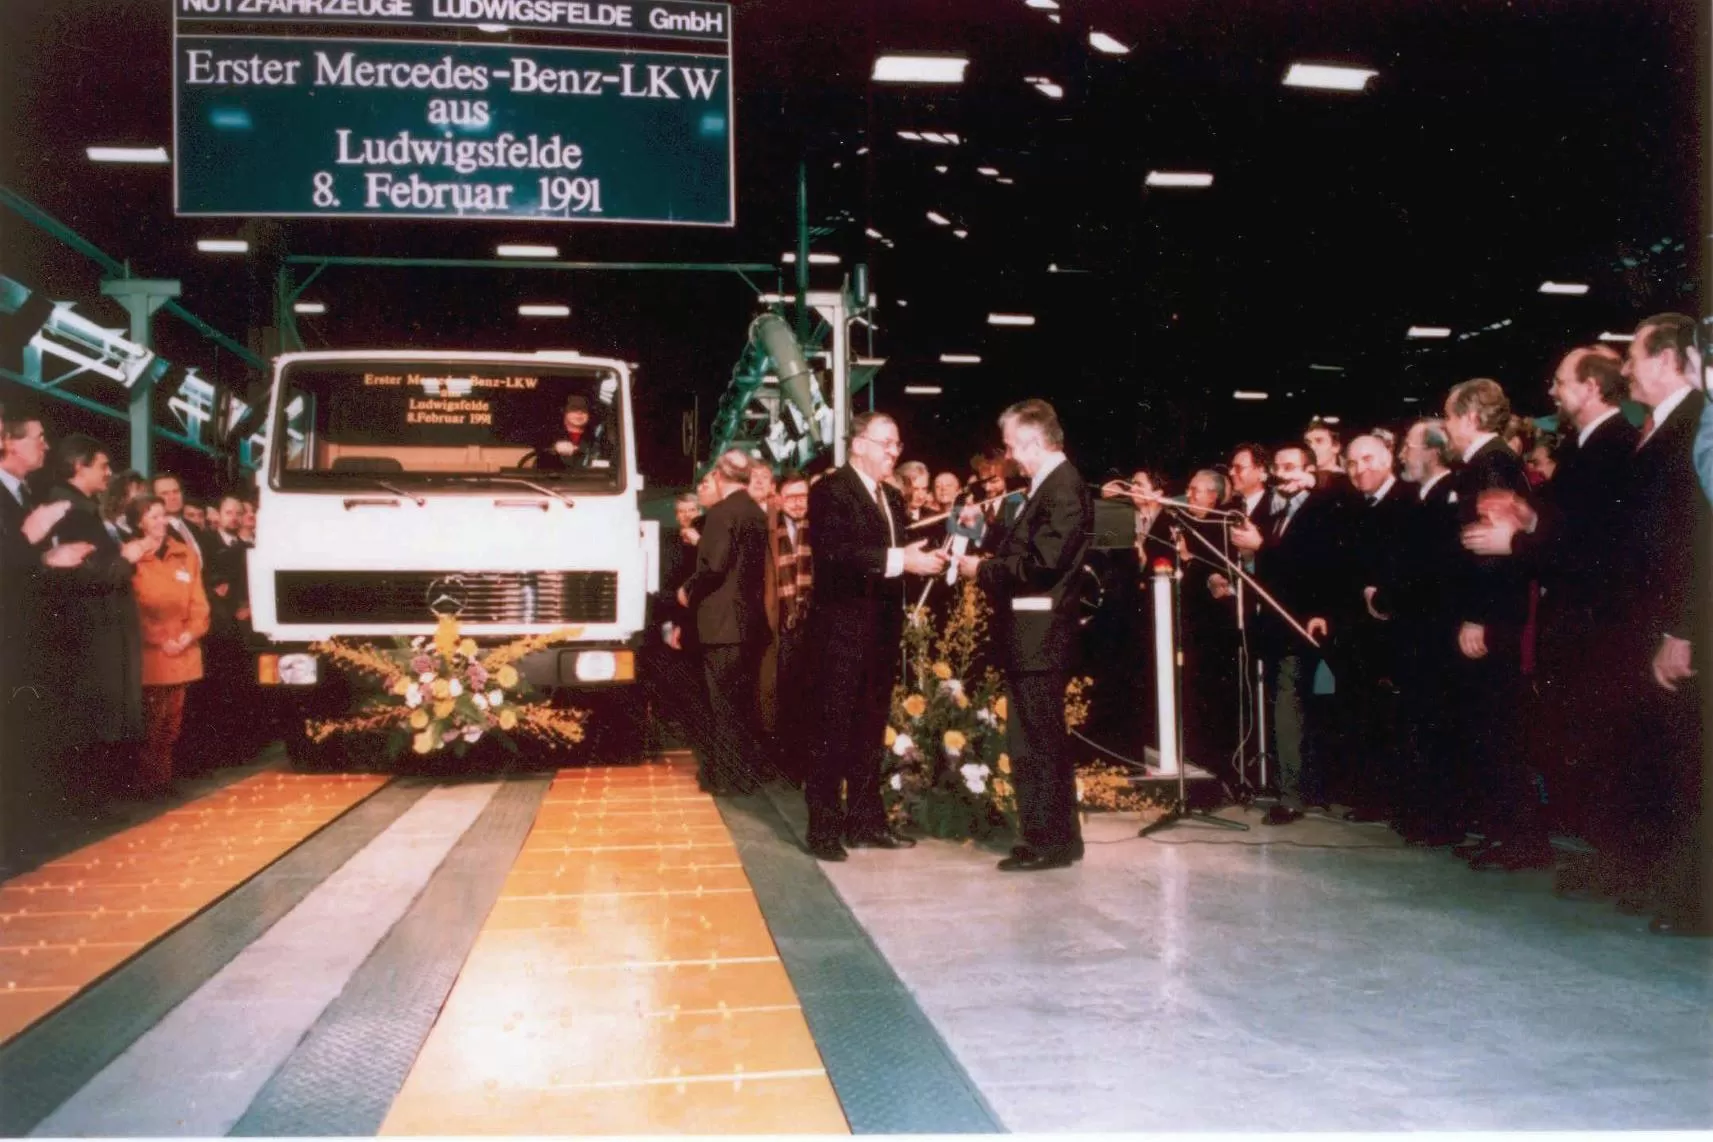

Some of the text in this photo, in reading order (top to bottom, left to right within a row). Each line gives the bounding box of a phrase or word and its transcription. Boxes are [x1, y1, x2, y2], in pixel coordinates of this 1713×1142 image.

[182, 0, 723, 33] NUTZFAHRZEUGE LUDWIGSFELDE GmbH
[186, 49, 721, 100] Erster Mercedes-Benz-LKW
[428, 98, 489, 125] aus
[335, 128, 583, 174] Ludwigsfelde
[312, 171, 603, 212] 8. Februar 1991
[364, 373, 402, 385] Erster
[409, 398, 489, 412] Ludwigsfelde
